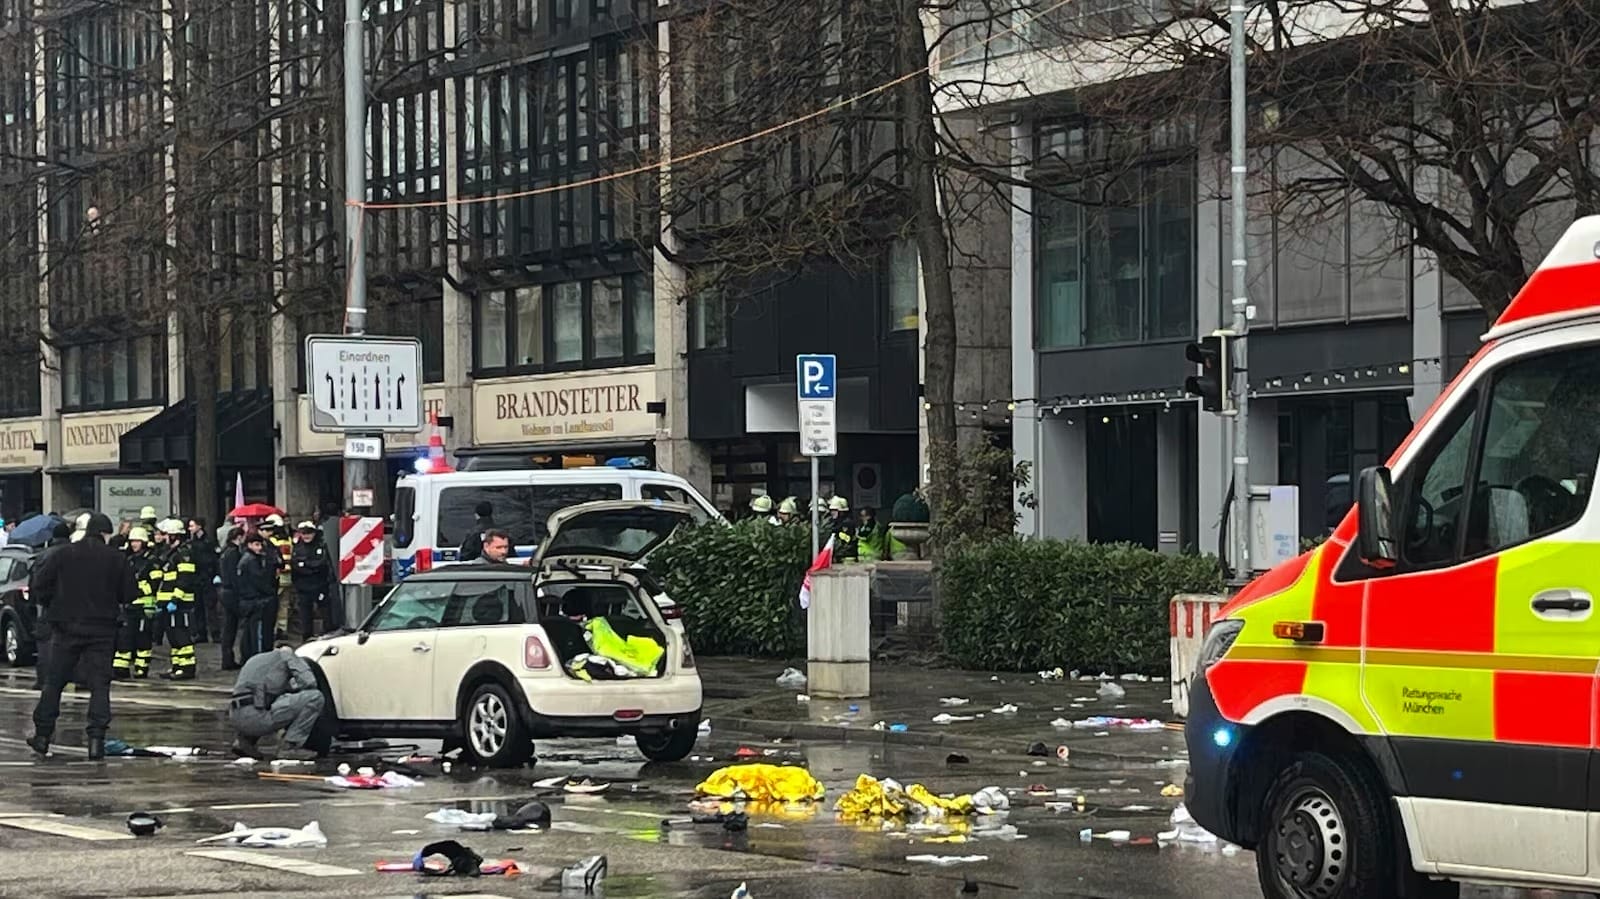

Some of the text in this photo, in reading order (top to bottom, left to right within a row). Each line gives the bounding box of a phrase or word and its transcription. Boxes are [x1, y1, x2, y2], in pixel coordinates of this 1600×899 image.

[339, 350, 390, 362] Einordnen
[803, 360, 824, 394] P
[496, 384, 642, 420] BRANDSTETTER
[351, 441, 375, 453] 150 m
[109, 486, 162, 497] Seidlstr. 30
[1402, 686, 1463, 702] Rettungswache
[1402, 701, 1445, 715] München
